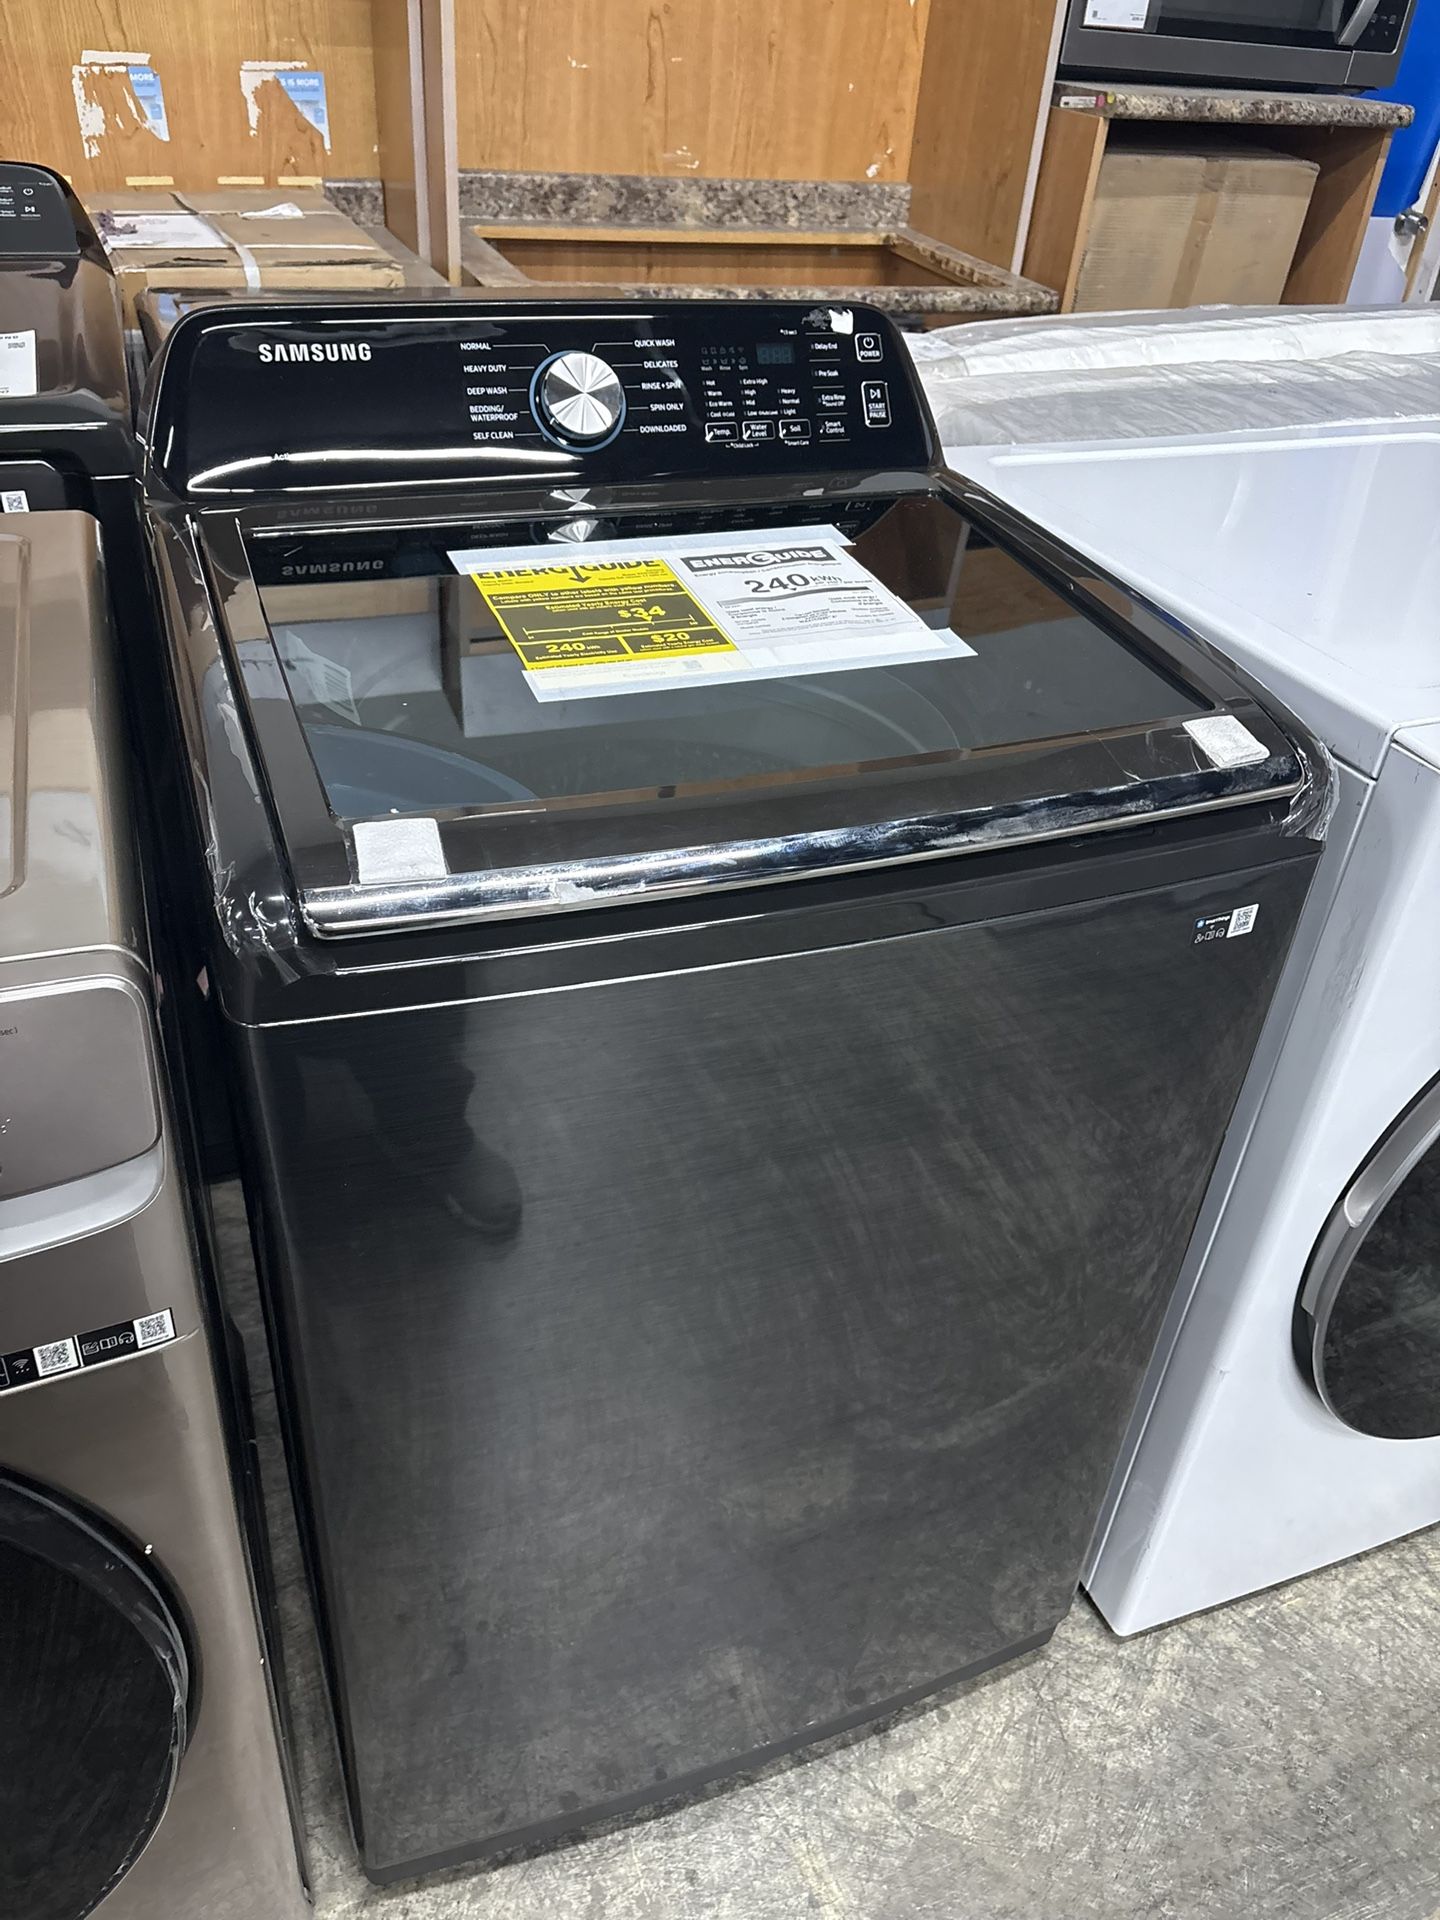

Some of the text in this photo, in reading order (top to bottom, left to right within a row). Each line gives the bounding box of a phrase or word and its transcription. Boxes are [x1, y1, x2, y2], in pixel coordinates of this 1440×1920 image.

[460, 342, 491, 350] NORMAL
[634, 339, 675, 347] QUICK WASH
[815, 343, 828, 351] Delay
[258, 343, 372, 363] SAMSUNG
[860, 350, 880, 358] POWER
[464, 364, 507, 373] HEAVY DUTY
[644, 360, 678, 369] DELICATES
[641, 382, 660, 390] RINSE
[666, 382, 682, 390] SPIN
[467, 387, 507, 395] DEEP WASH
[469, 405, 505, 414] BEDDING/
[650, 403, 684, 411] SPIN ONLY
[470, 412, 519, 422] WATERPROOF
[640, 424, 687, 433] DOWNLOADED
[713, 428, 731, 436] Temp.
[473, 431, 514, 440] SELF CLEAN
[744, 573, 842, 593] 240 kWh
[493, 593, 527, 601] Compare
[618, 606, 666, 619] $34
[651, 632, 690, 643] $20
[545, 642, 586, 653] 240
